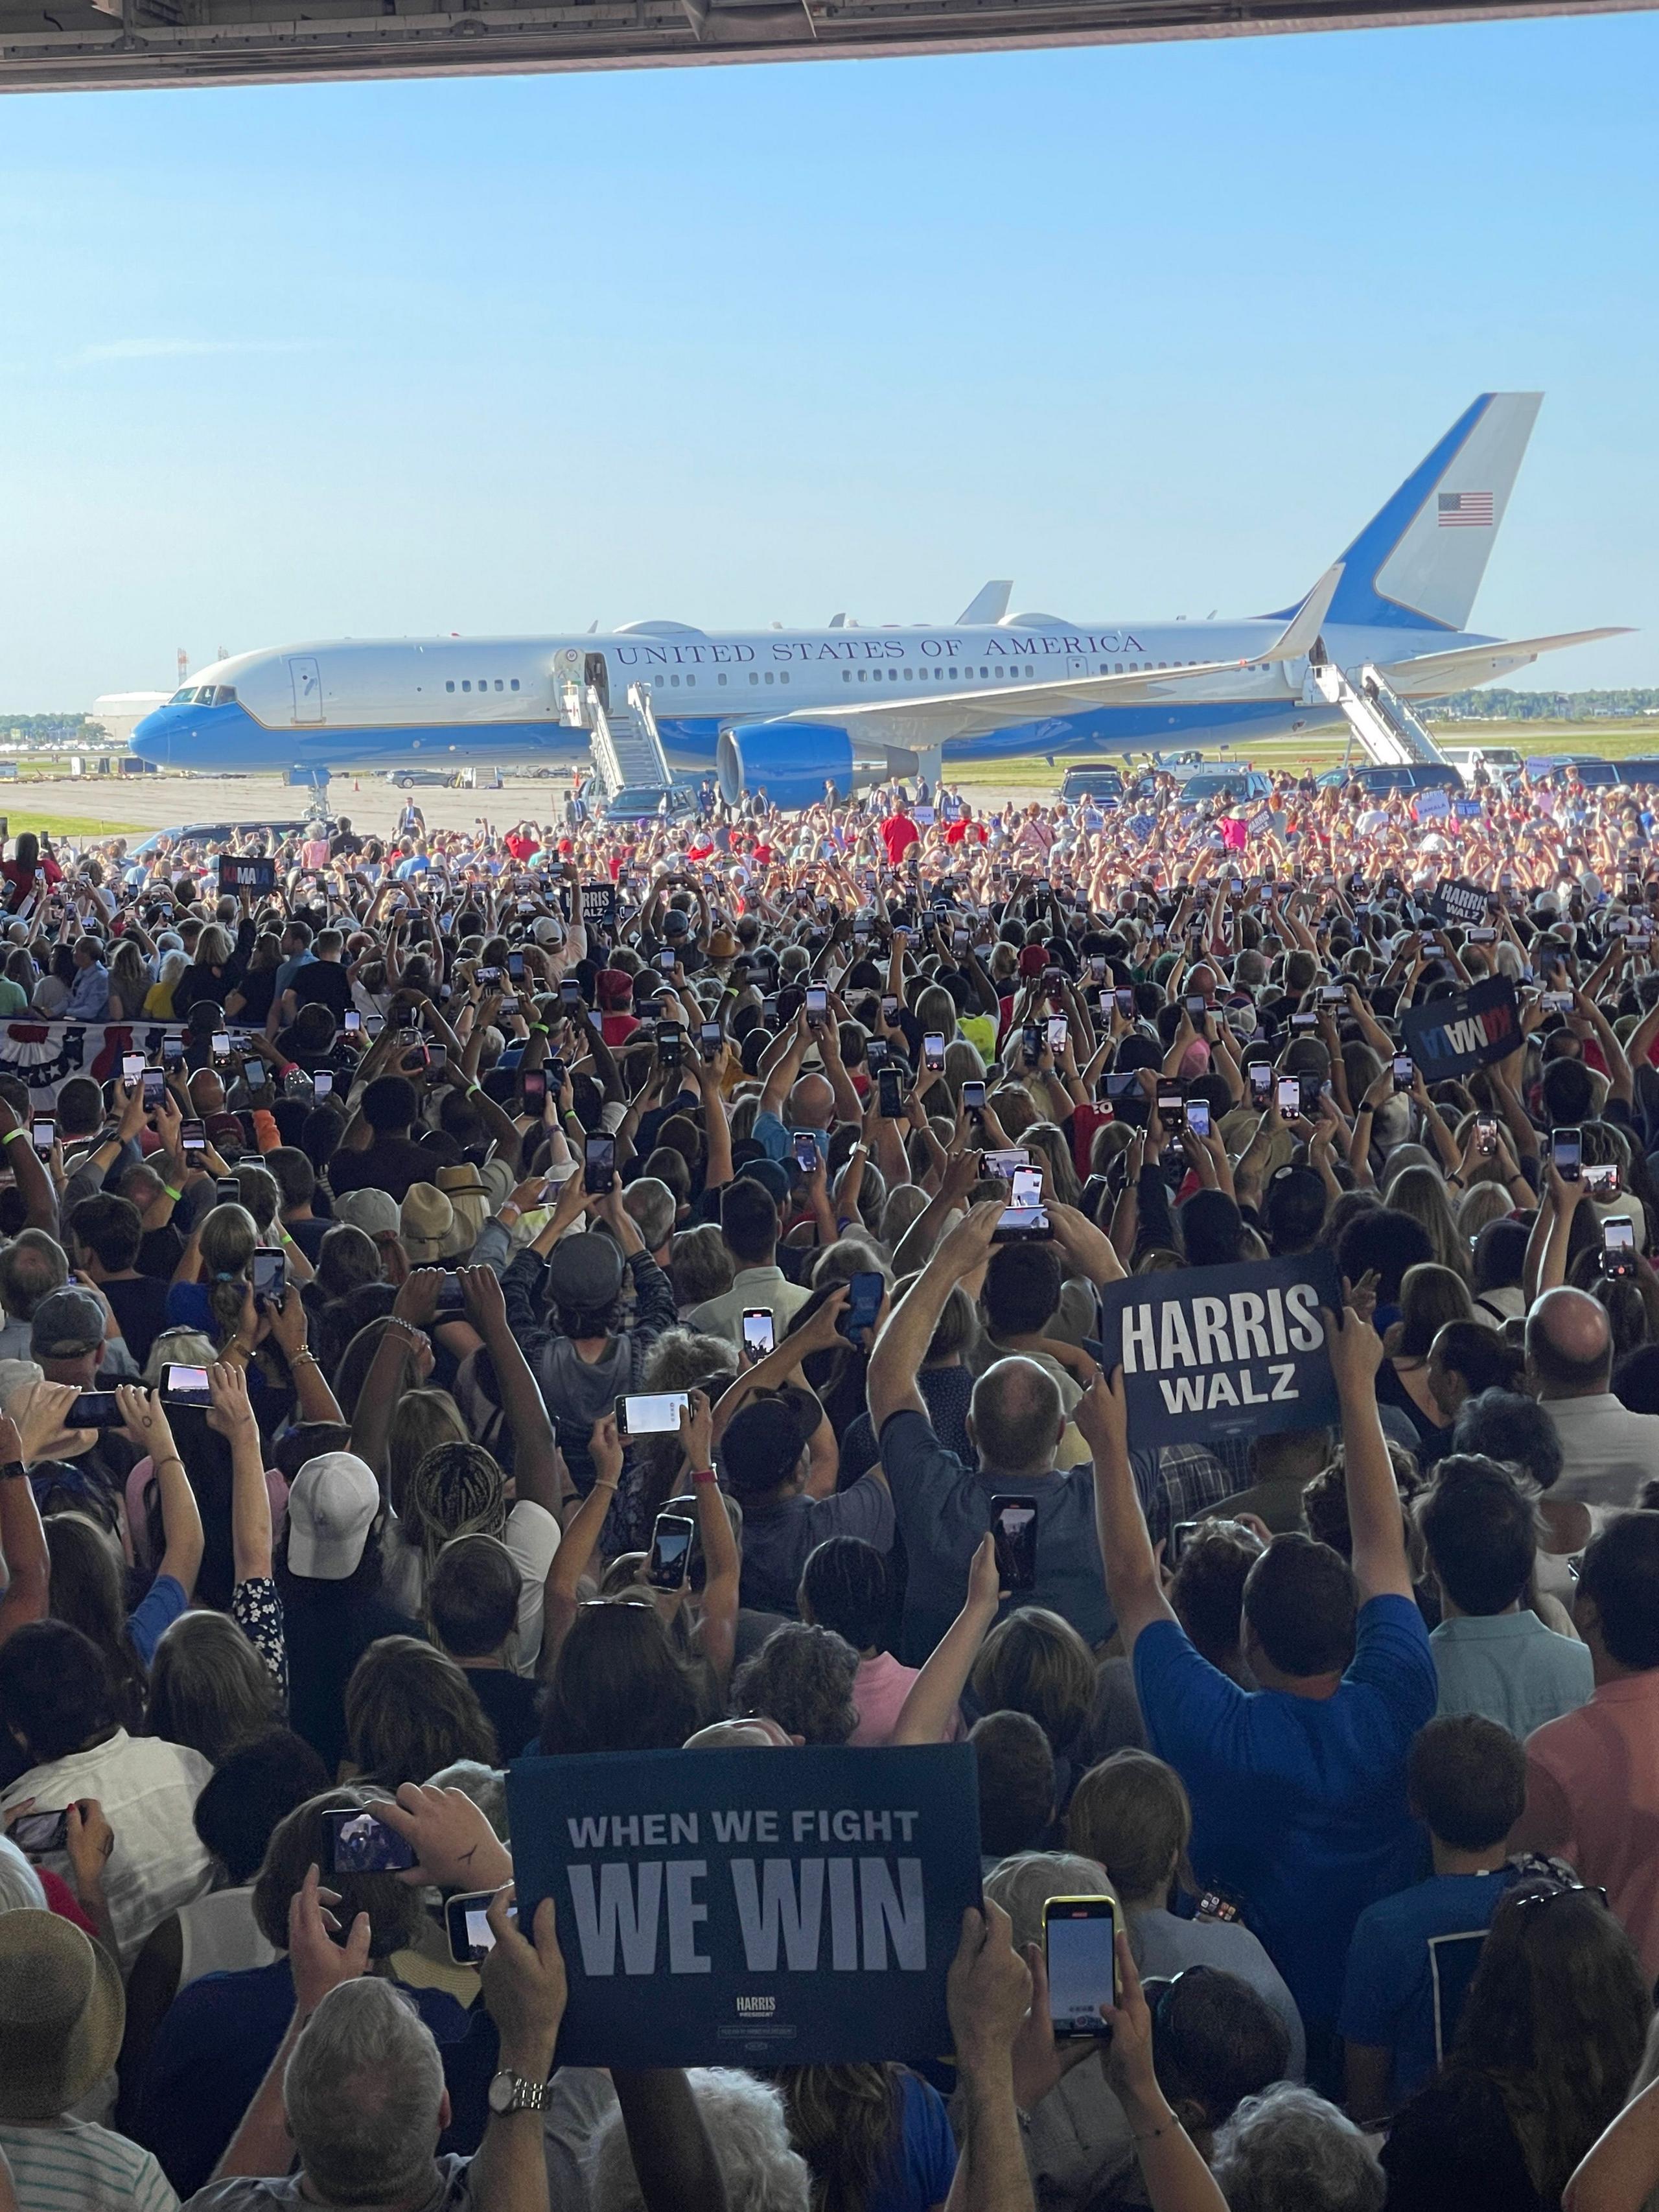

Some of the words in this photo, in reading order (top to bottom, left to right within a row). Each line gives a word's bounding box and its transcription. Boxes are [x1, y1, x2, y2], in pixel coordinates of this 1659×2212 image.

[614, 644, 755, 665] UNITED
[772, 640, 905, 660] STATES
[921, 639, 963, 657] OF
[983, 635, 1147, 655] AMERICA
[1248, 810, 1270, 832] HARRIS
[222, 866, 270, 885] KAMALA
[566, 891, 610, 907] HRRIS
[583, 907, 603, 917] ALZ
[1446, 903, 1479, 920] WALZ
[1122, 1284, 1324, 1373] HARRIS
[1159, 1363, 1299, 1414] WALZ
[567, 1812, 699, 1848] WHEN
[711, 1810, 780, 1843] WE
[792, 1810, 919, 1843] FIGHT
[566, 1859, 712, 1977] WE
[730, 1857, 927, 1972] WIN
[736, 1997, 776, 2011] HARRIS
